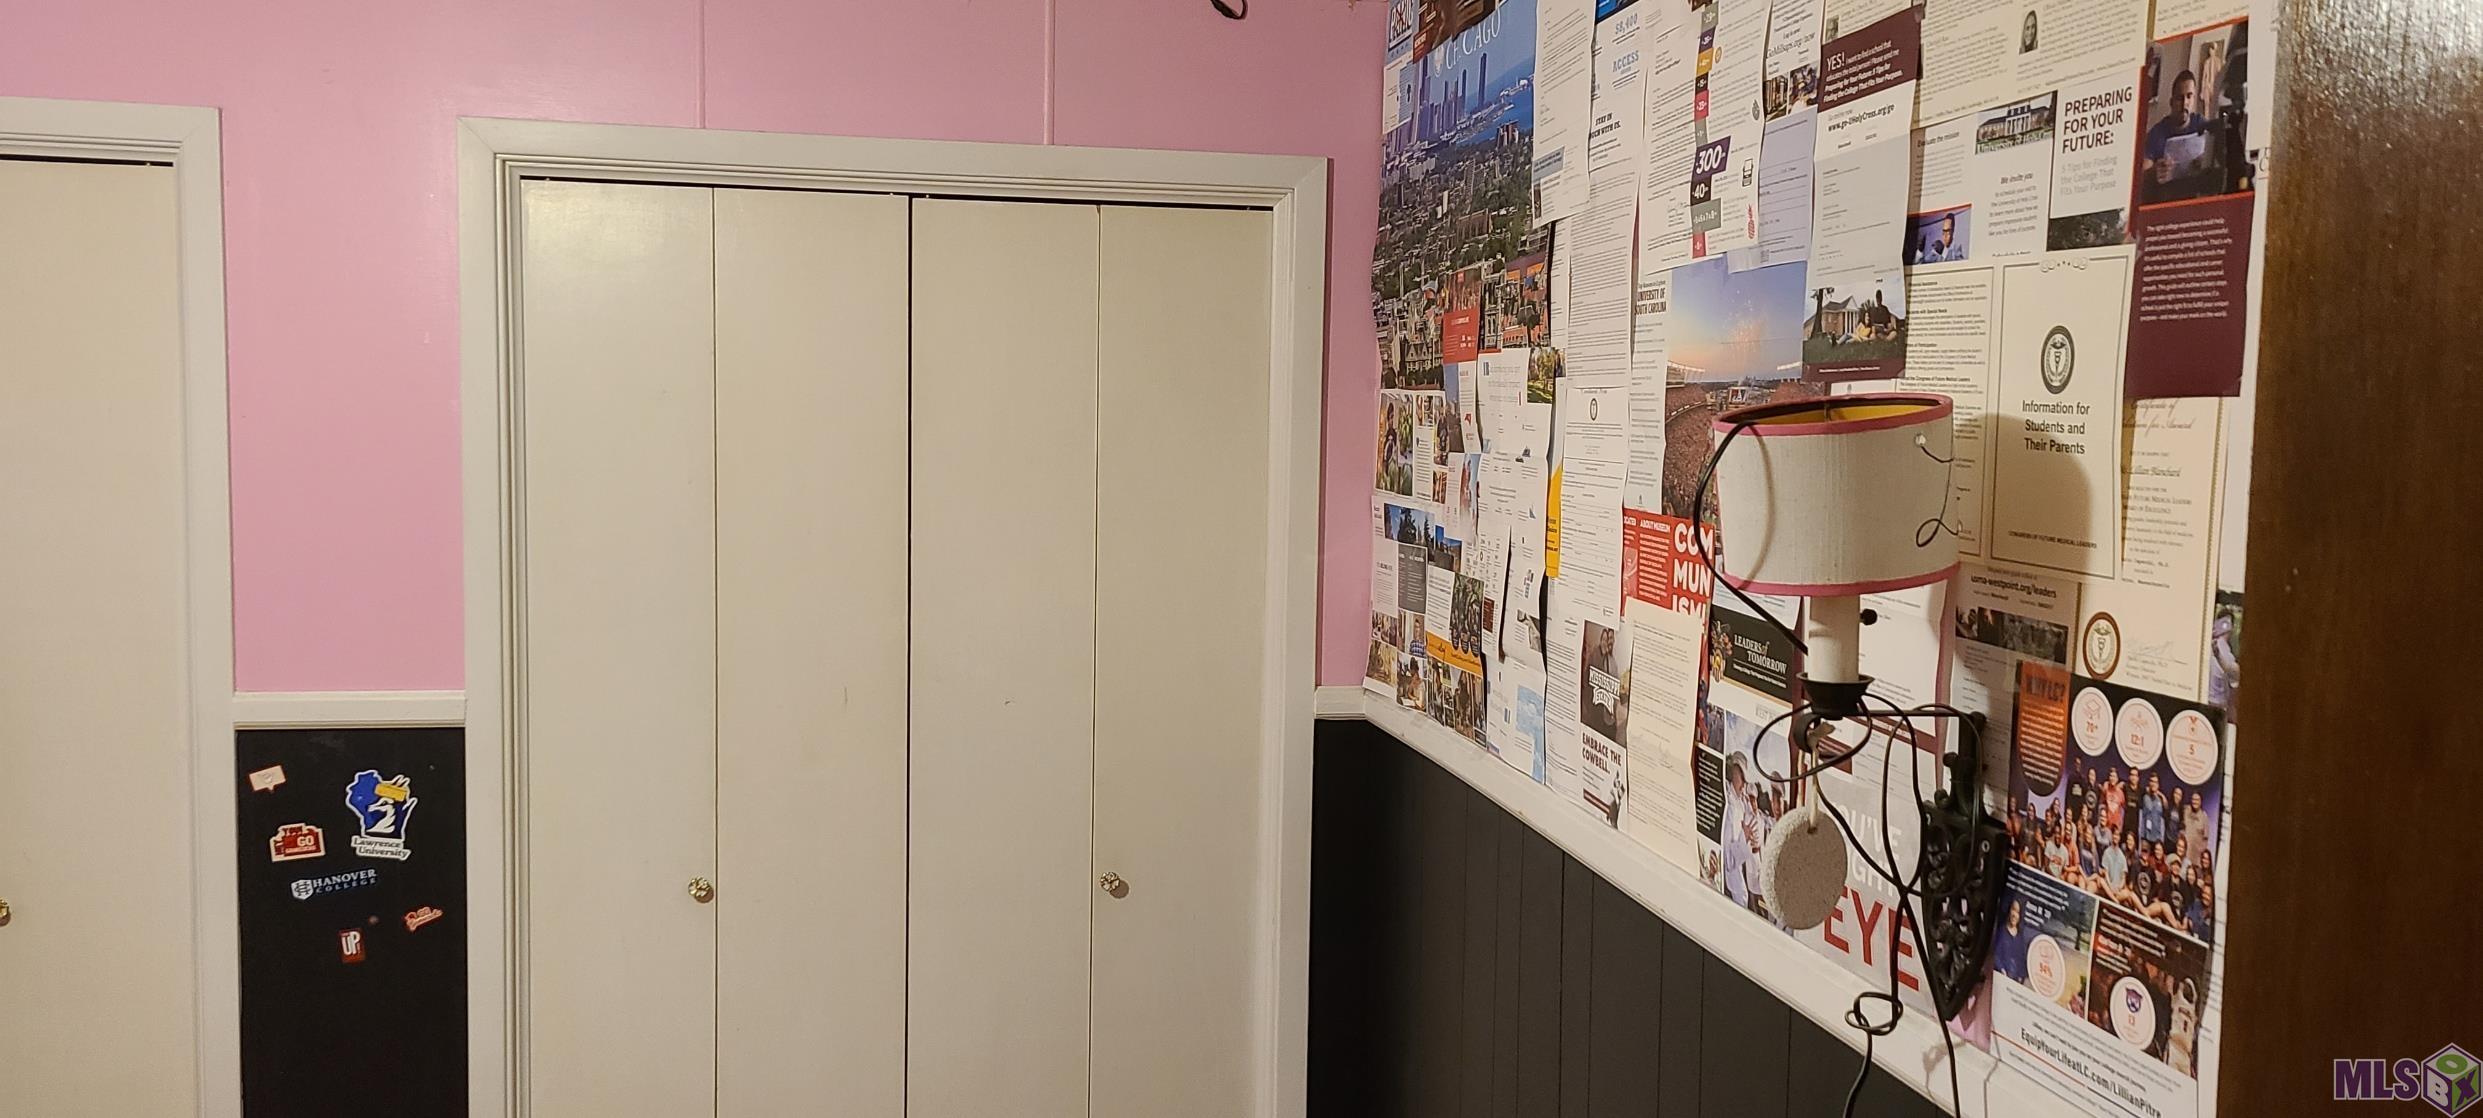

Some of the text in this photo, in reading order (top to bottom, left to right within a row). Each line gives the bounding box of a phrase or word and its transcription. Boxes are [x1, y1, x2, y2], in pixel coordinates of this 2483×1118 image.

[1612, 50, 1640, 73] ACCESS
[1827, 51, 1845, 71] YES!
[2065, 86, 2132, 117] PREPARING
[2063, 108, 2124, 136] FOR YOUR
[2062, 130, 2114, 154] FUTURE:
[2068, 162, 2081, 172] Tips
[2082, 160, 2092, 169] for
[2093, 155, 2117, 167] Finding
[2061, 167, 2114, 185] the College That
[2090, 180, 2116, 192] Purpose
[2022, 400, 2090, 415] Information for
[2025, 418, 2086, 435] Students and
[2024, 437, 2085, 455] Their Parents
[1674, 522, 1714, 560] COM
[1673, 558, 1712, 597] MUN
[1734, 634, 1762, 653] LEADERS
[1747, 650, 1787, 675] TOMORROW
[1589, 668, 1620, 697] MISSISSIPPI
[1582, 732, 1622, 767] EMBRACE THE
[1582, 748, 1611, 774] COWBELL.
[297, 835, 315, 847] GO
[354, 837, 401, 848] Lawrence
[358, 847, 409, 858] University
[313, 869, 377, 888] HANOVER
[316, 878, 376, 894] COLLEGE
[1824, 885, 1919, 991] EYE
